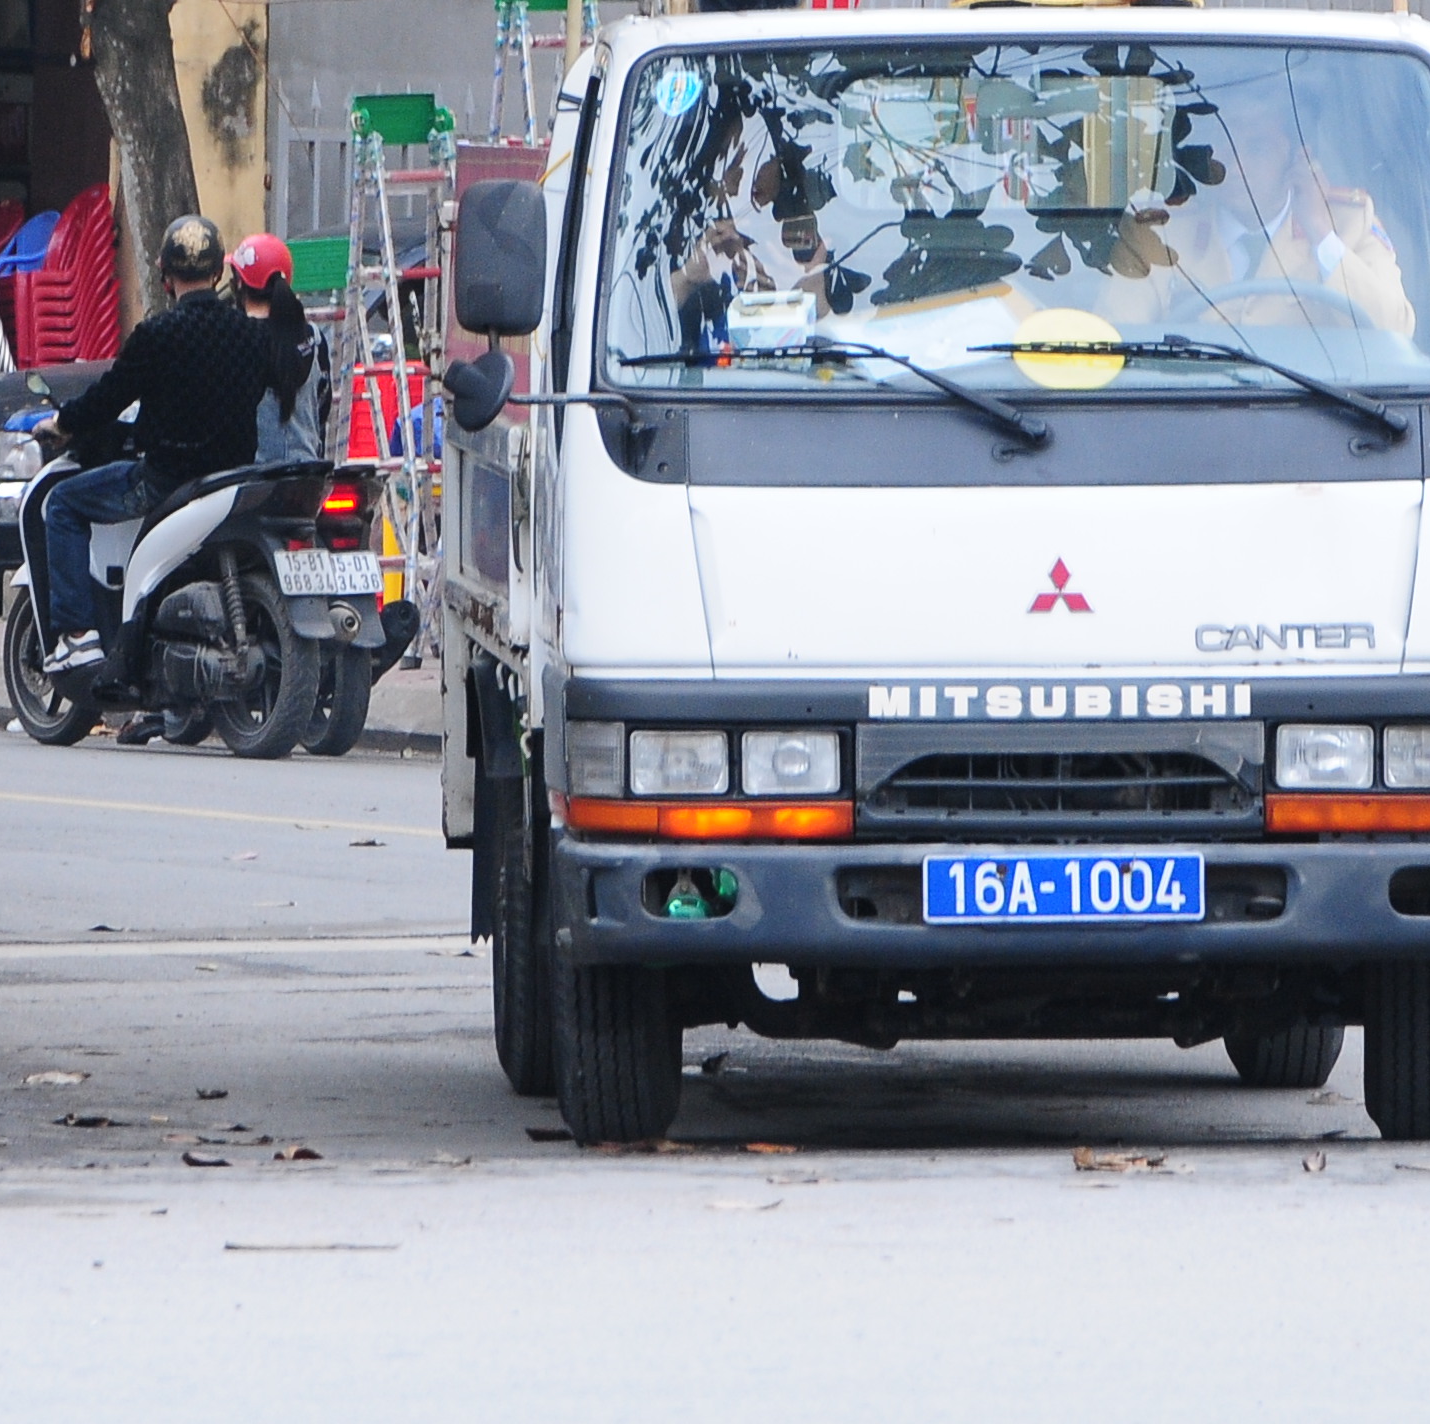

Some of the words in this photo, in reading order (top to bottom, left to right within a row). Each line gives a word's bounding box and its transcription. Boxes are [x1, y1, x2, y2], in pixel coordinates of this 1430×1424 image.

[1195, 622, 1376, 652] CANTER
[867, 684, 1252, 718] MITSUBISHI
[948, 859, 1186, 914] 16A-1004
